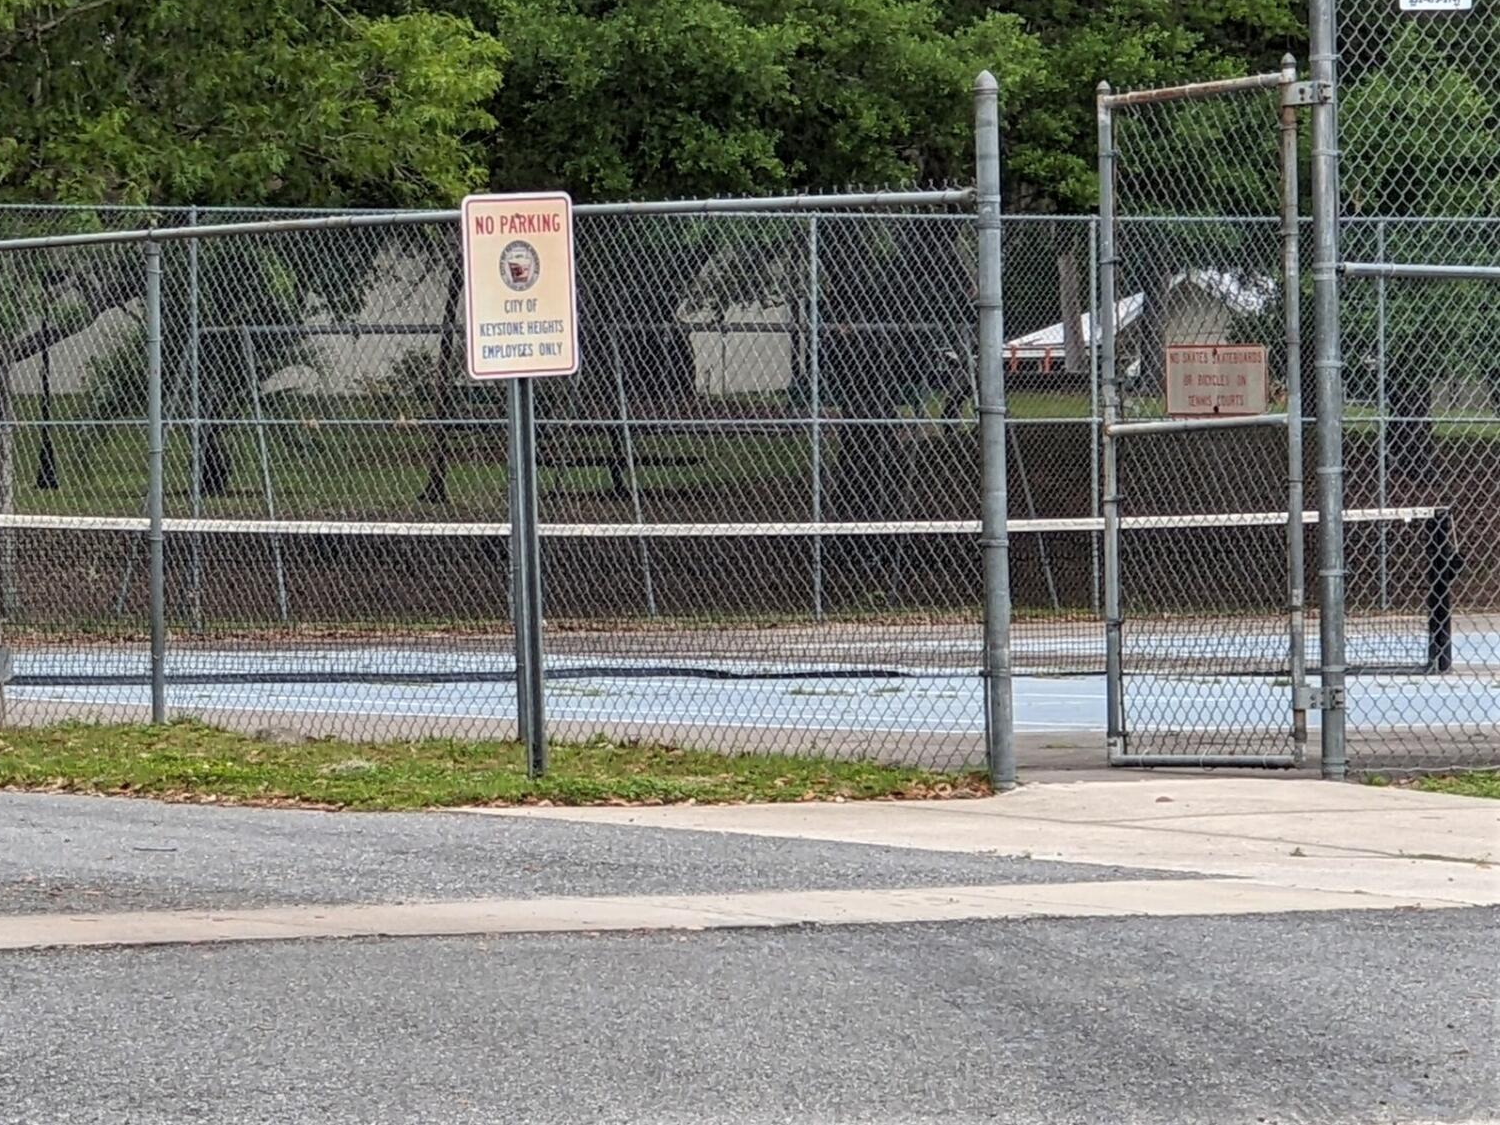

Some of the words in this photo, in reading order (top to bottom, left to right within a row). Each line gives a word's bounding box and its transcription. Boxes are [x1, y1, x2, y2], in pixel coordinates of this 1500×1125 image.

[475, 215, 494, 235] NO
[500, 213, 561, 234] PARKING
[504, 300, 523, 313] CITY
[526, 298, 537, 312] OF
[479, 322, 525, 337] KEYSTONE
[527, 320, 564, 334] HEIGHTS
[482, 343, 533, 359] EMPLOYEES
[539, 342, 563, 356] ONLY
[1182, 352, 1208, 364] SKATES
[1212, 352, 1261, 364] SKATEBOARDS
[1188, 395, 1212, 406] TENNIS
[1217, 395, 1244, 406] COURTS
